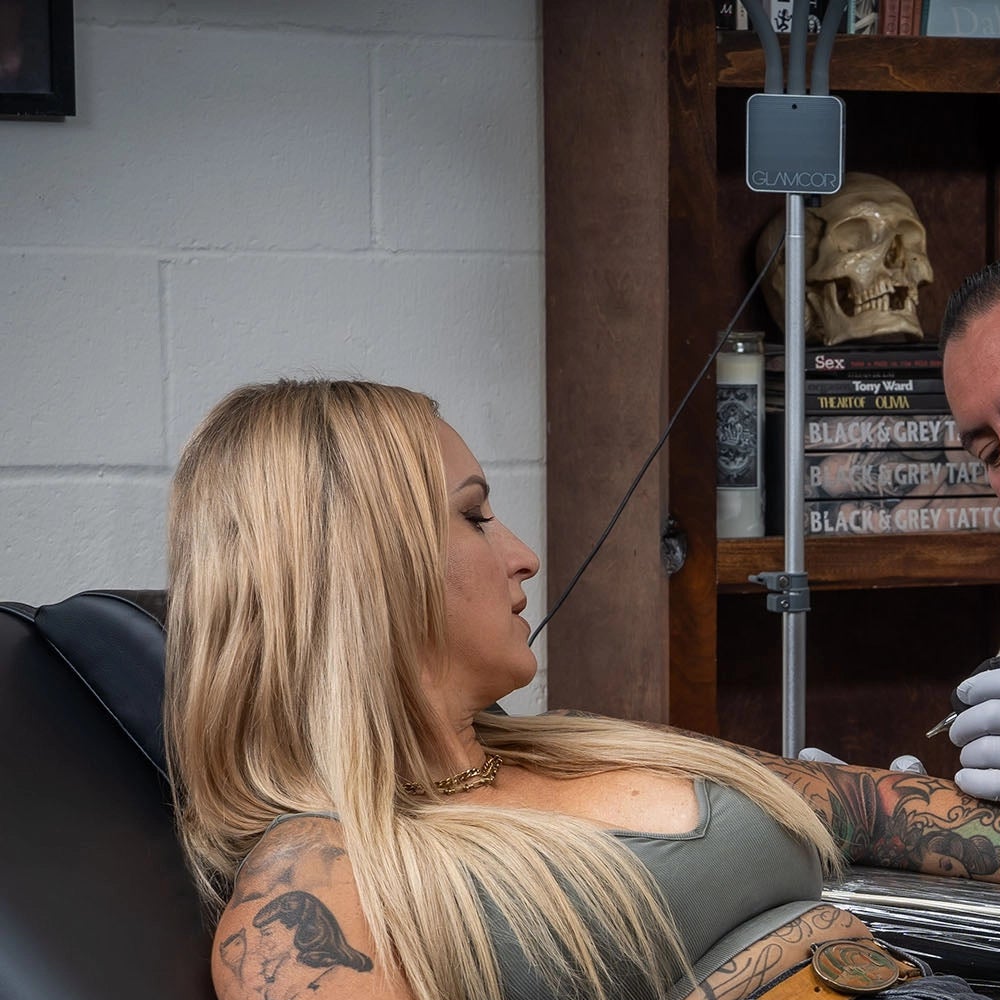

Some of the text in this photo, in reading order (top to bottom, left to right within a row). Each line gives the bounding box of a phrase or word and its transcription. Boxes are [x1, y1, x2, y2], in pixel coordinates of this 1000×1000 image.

[752, 170, 836, 188] GLAMCOR
[815, 355, 845, 369] Sex
[852, 381, 880, 394] Tony
[882, 380, 913, 391] Ward
[875, 396, 910, 409] OLIVIA
[809, 422, 874, 443] BLACK
[877, 424, 890, 443] &
[894, 421, 943, 442] GREY
[810, 464, 874, 486] BLACK
[878, 464, 892, 485] &
[894, 463, 944, 484] GREY
[810, 510, 874, 532] BLACK
[878, 510, 892, 531] &
[894, 509, 944, 530] GREY
